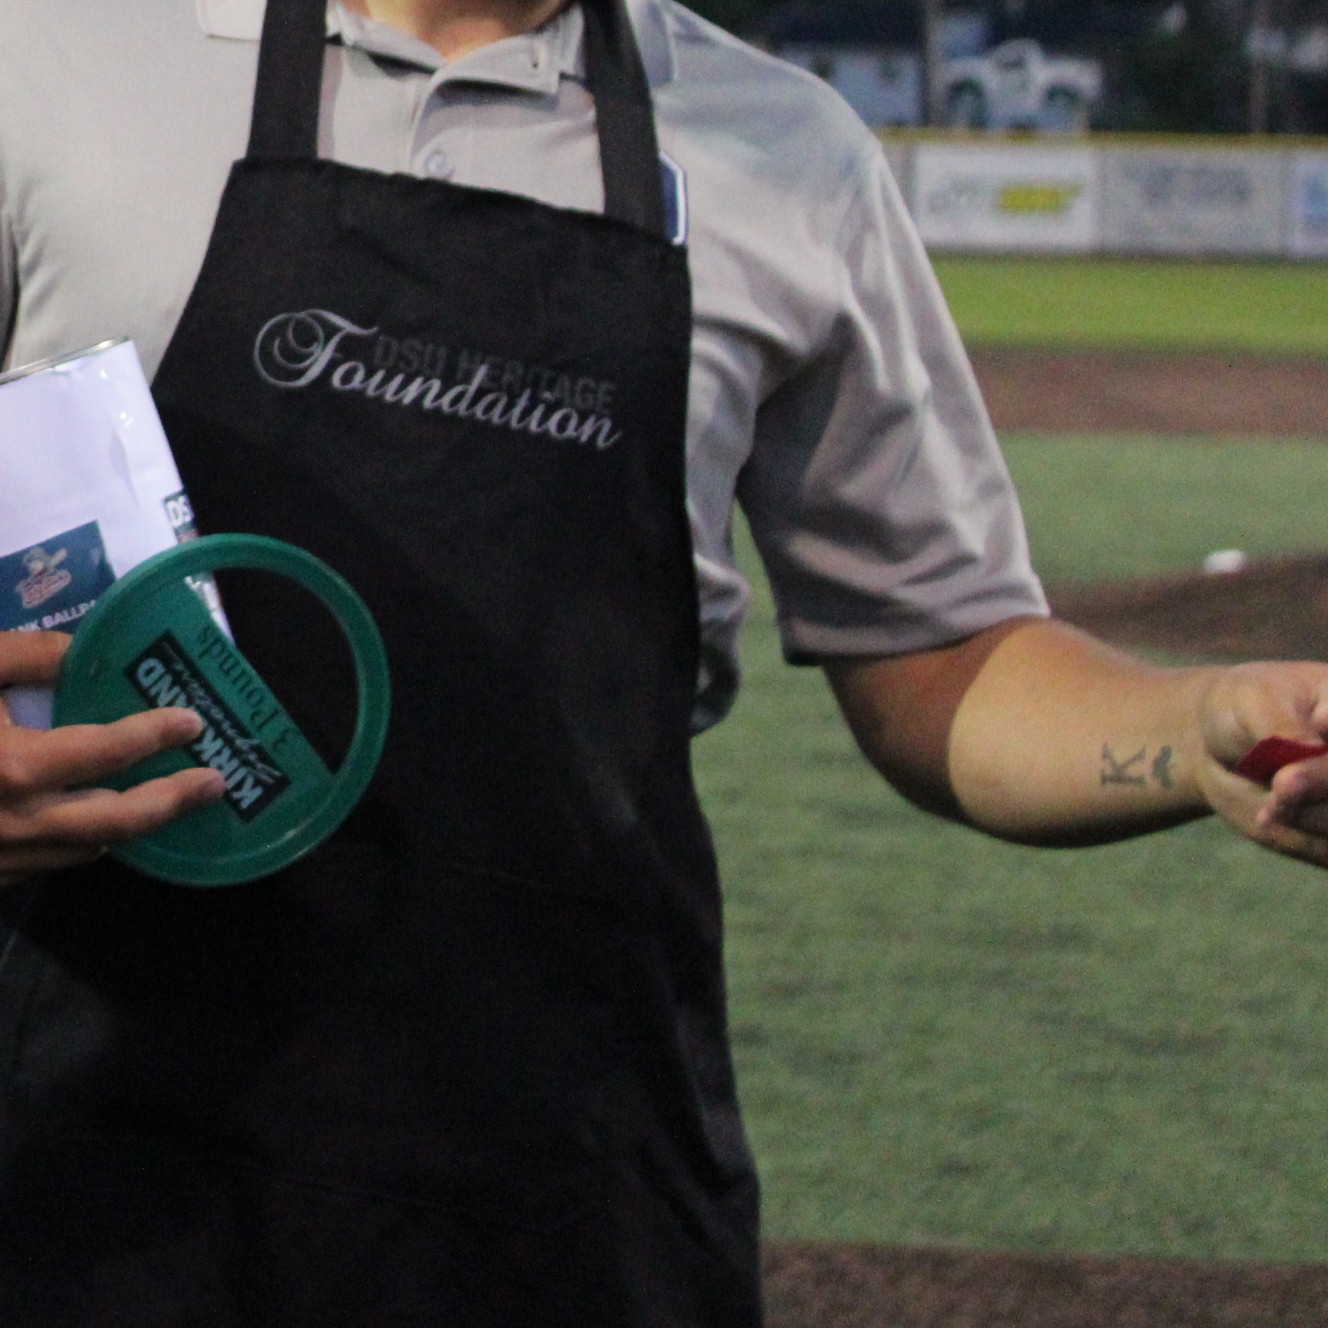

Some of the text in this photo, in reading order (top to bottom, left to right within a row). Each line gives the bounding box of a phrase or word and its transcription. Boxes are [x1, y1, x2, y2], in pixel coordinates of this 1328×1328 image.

[254, 308, 624, 451] Foundation
[135, 657, 264, 811] KIRKAND
[196, 624, 286, 733] Pounds
